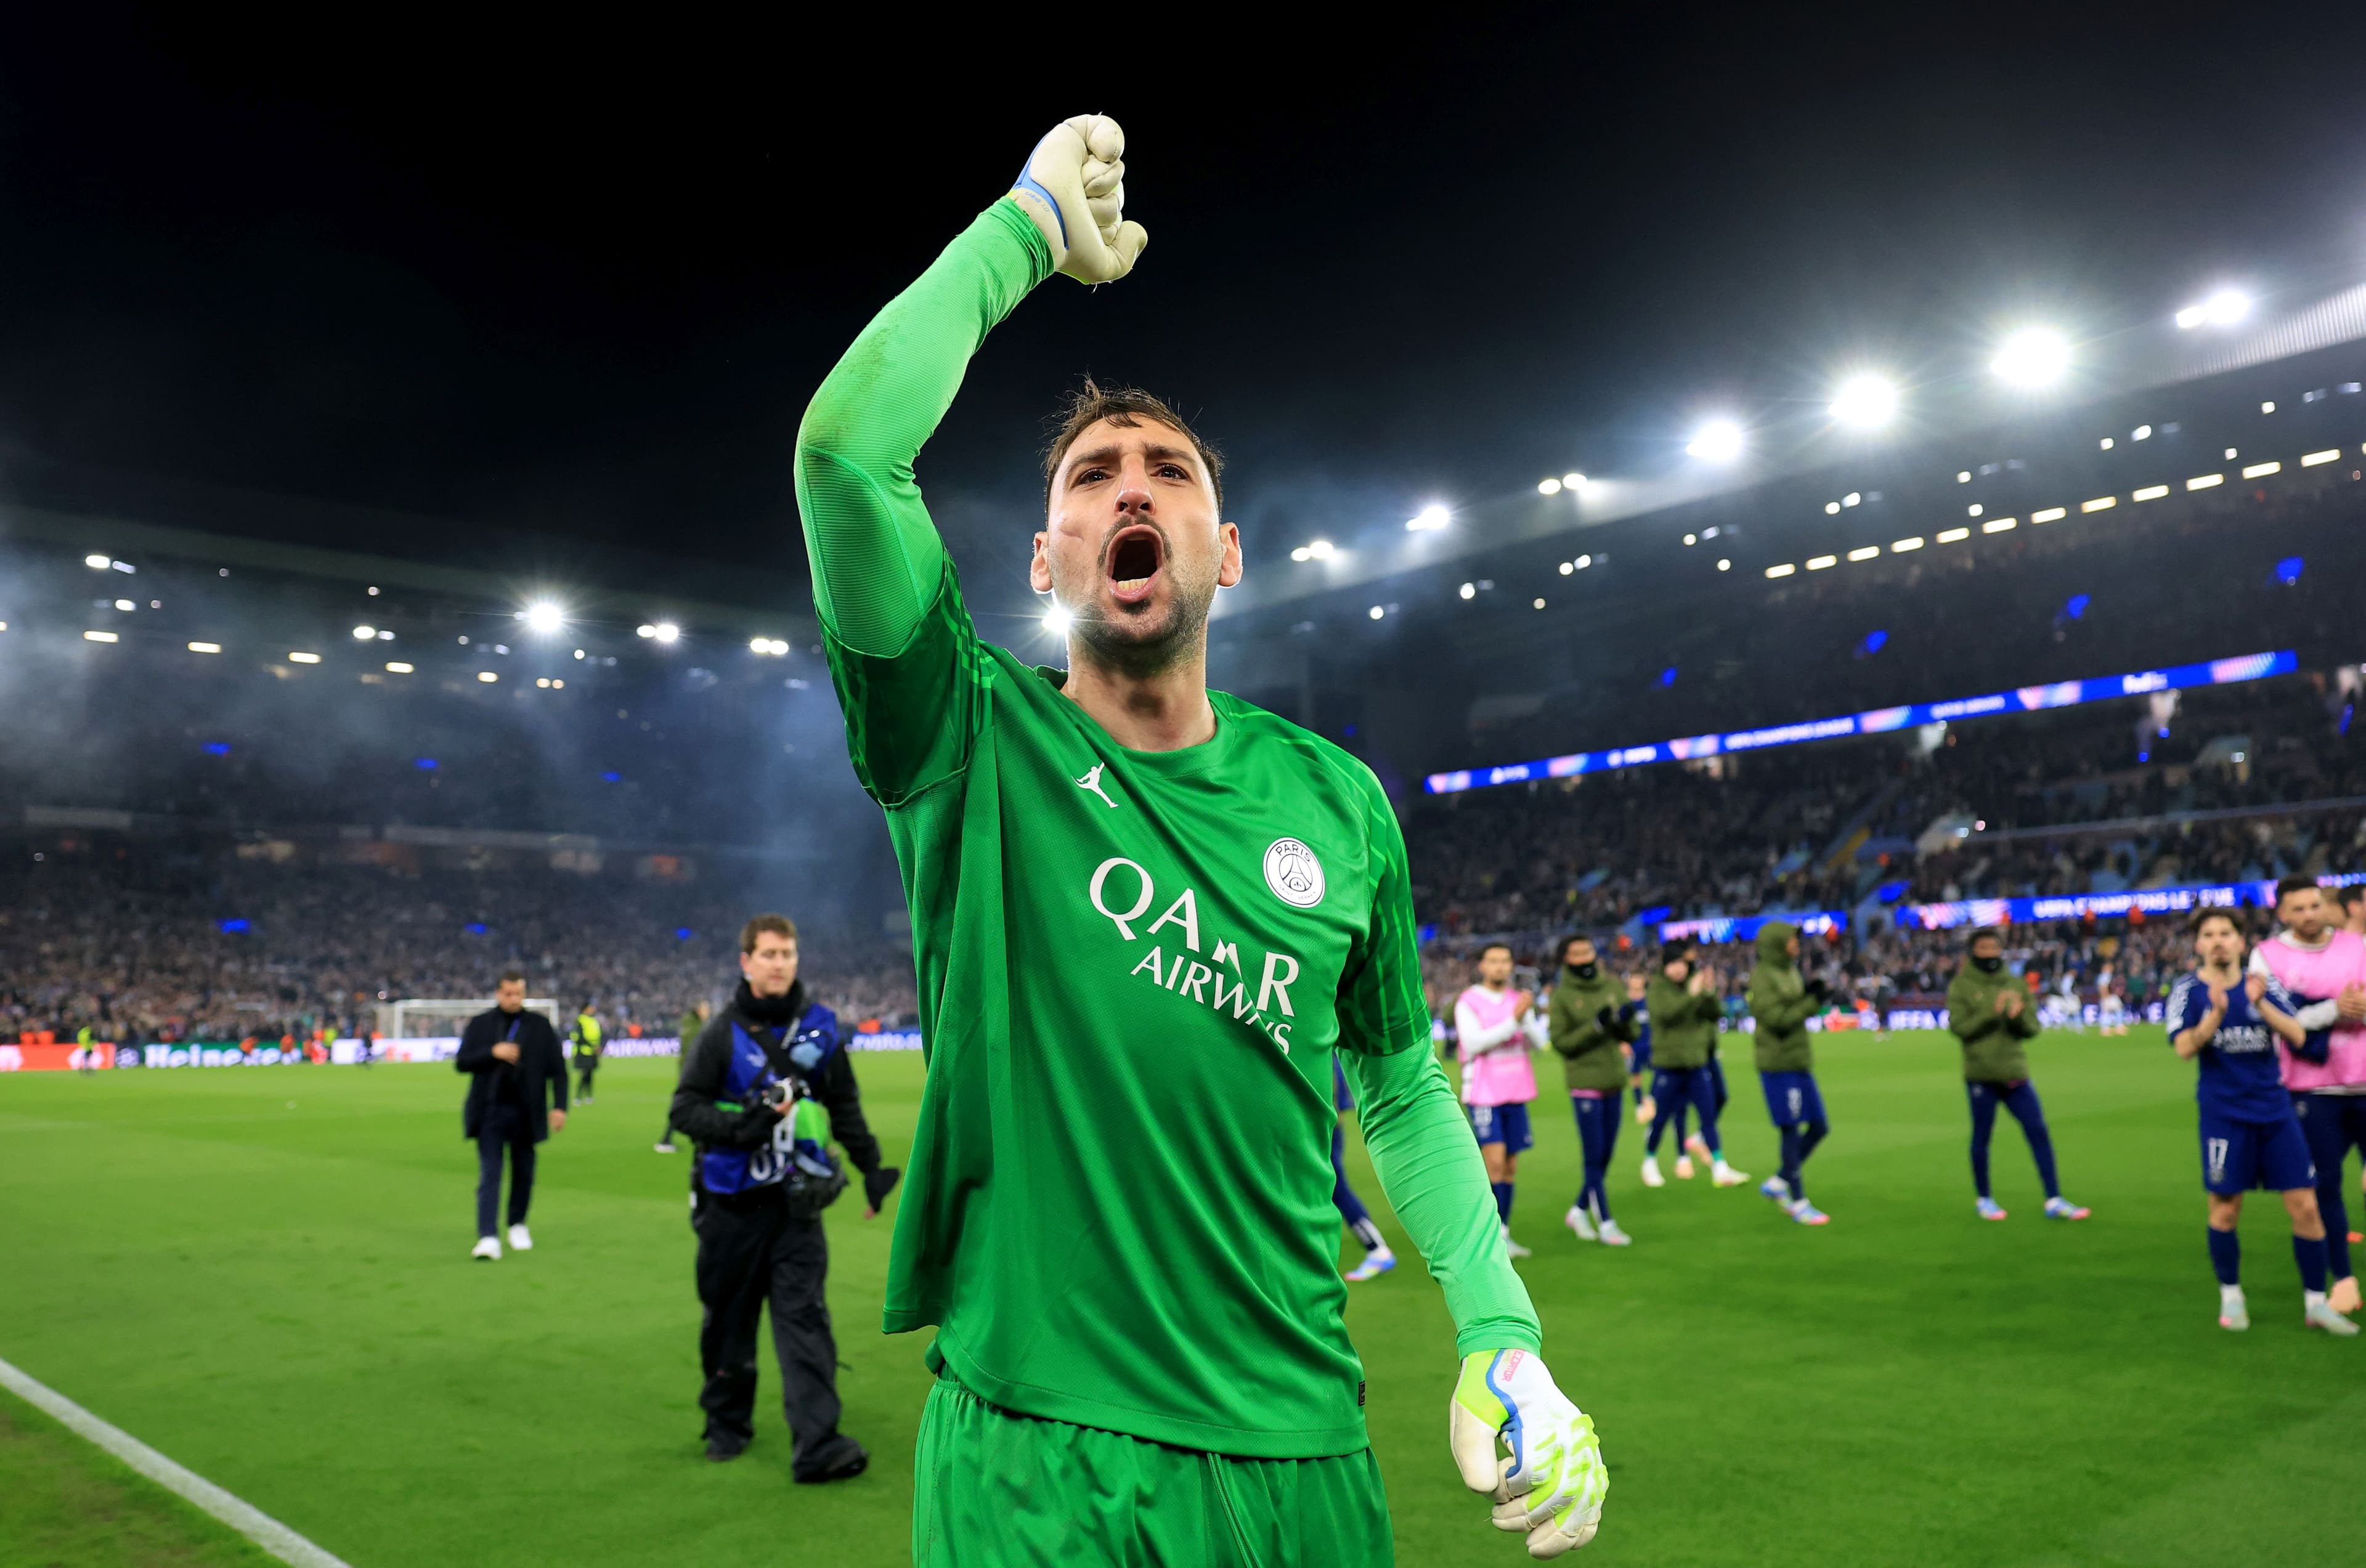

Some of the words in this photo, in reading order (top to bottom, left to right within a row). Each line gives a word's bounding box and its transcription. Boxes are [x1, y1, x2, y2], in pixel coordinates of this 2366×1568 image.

[1275, 843, 1312, 862] PARIS
[2169, 887, 2235, 910] LEGUE
[1089, 857, 1300, 1017] QAR
[1130, 944, 1292, 1056] AIRWS
[2208, 1137, 2229, 1169] 17
[1501, 1349, 1525, 1381] EDATOR
